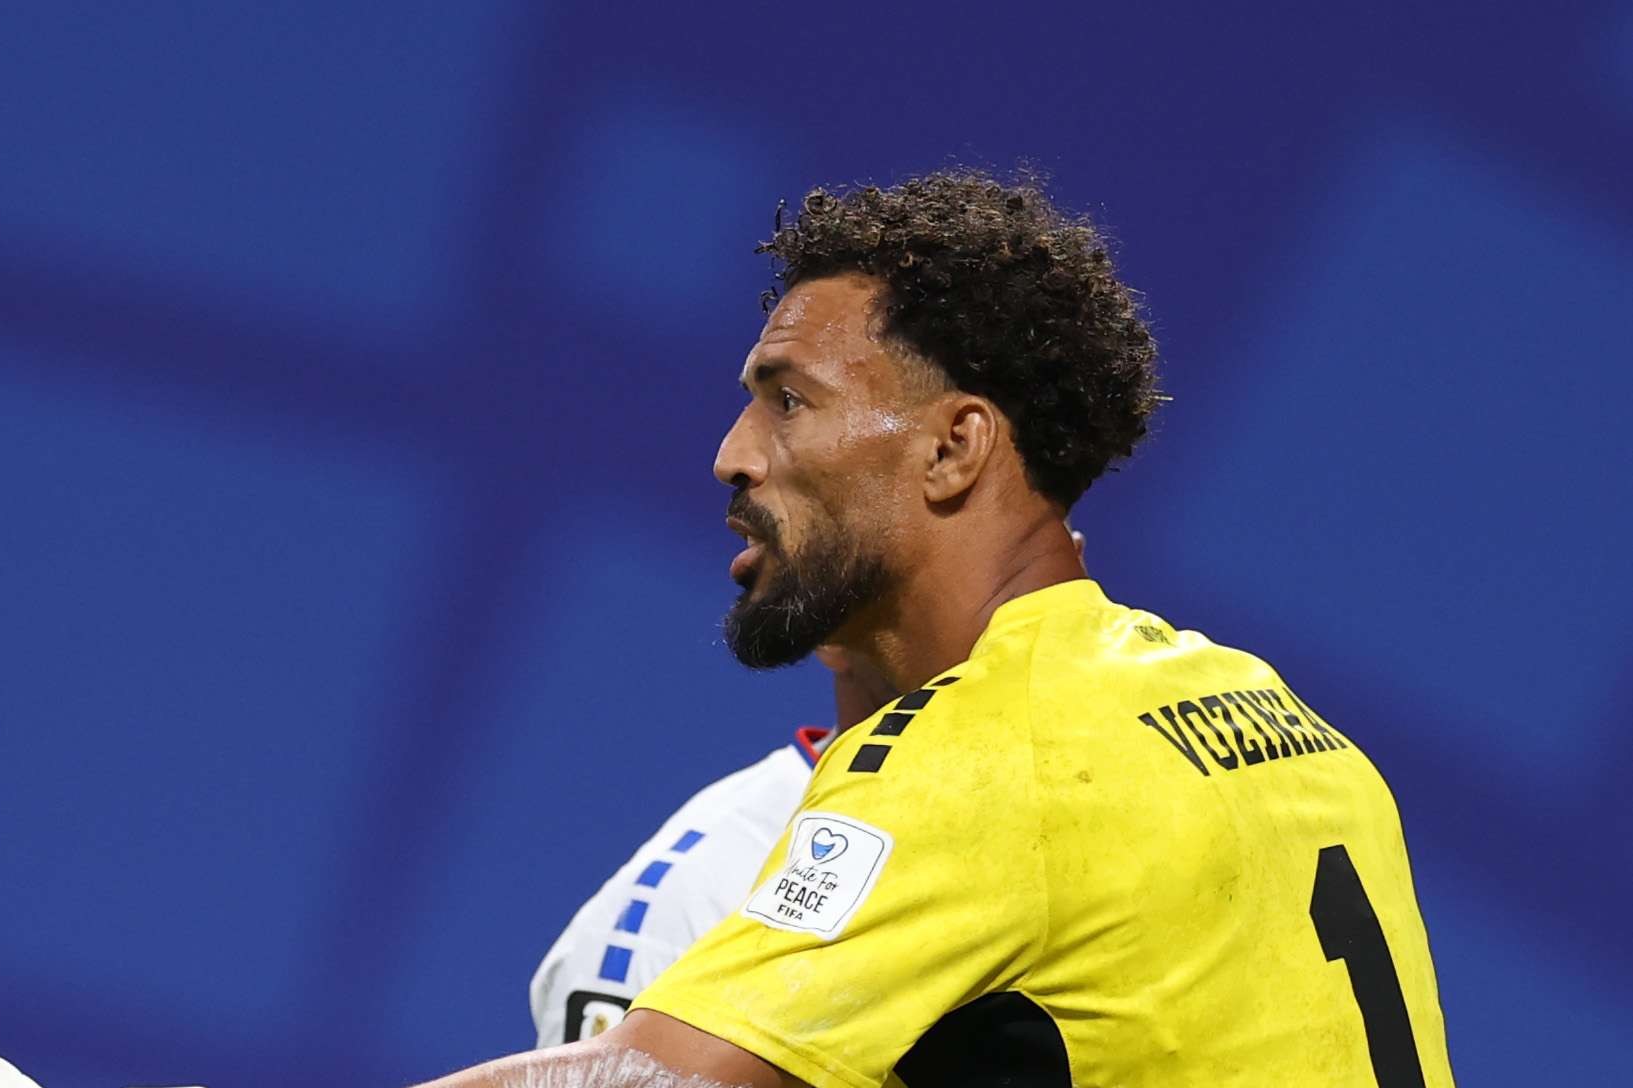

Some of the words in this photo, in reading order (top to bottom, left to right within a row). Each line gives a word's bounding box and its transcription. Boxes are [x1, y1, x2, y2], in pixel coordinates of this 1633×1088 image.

[1137, 686, 1349, 776] VOZINHA
[817, 871, 839, 891] For
[774, 877, 828, 914] PEACE
[777, 904, 803, 921] FIFA
